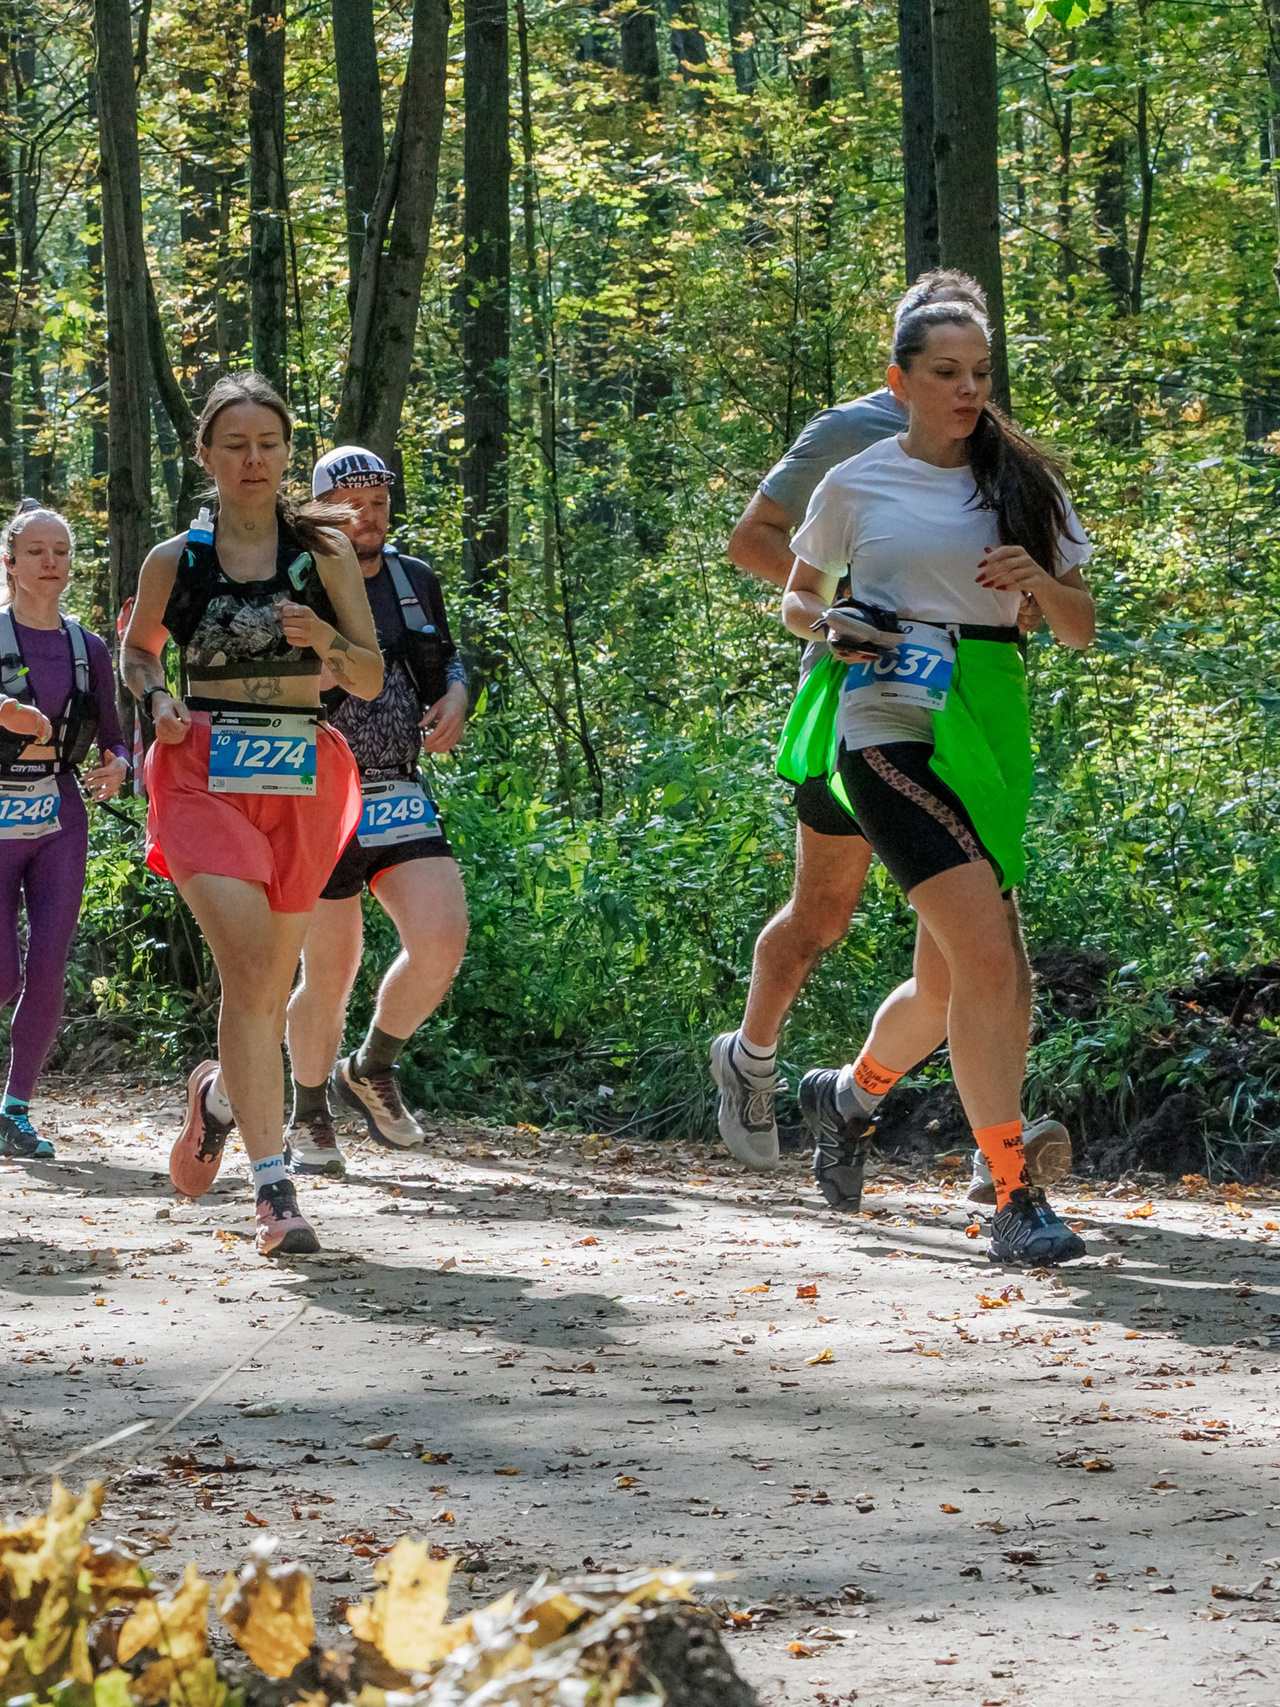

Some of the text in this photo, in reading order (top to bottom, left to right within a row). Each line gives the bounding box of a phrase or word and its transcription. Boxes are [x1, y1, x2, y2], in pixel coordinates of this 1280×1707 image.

[346, 474, 377, 482] WILD
[347, 480, 380, 489] TRAIL
[216, 736, 308, 768] 10 1274
[0, 797, 55, 820] 1248
[366, 798, 424, 826] 1249
